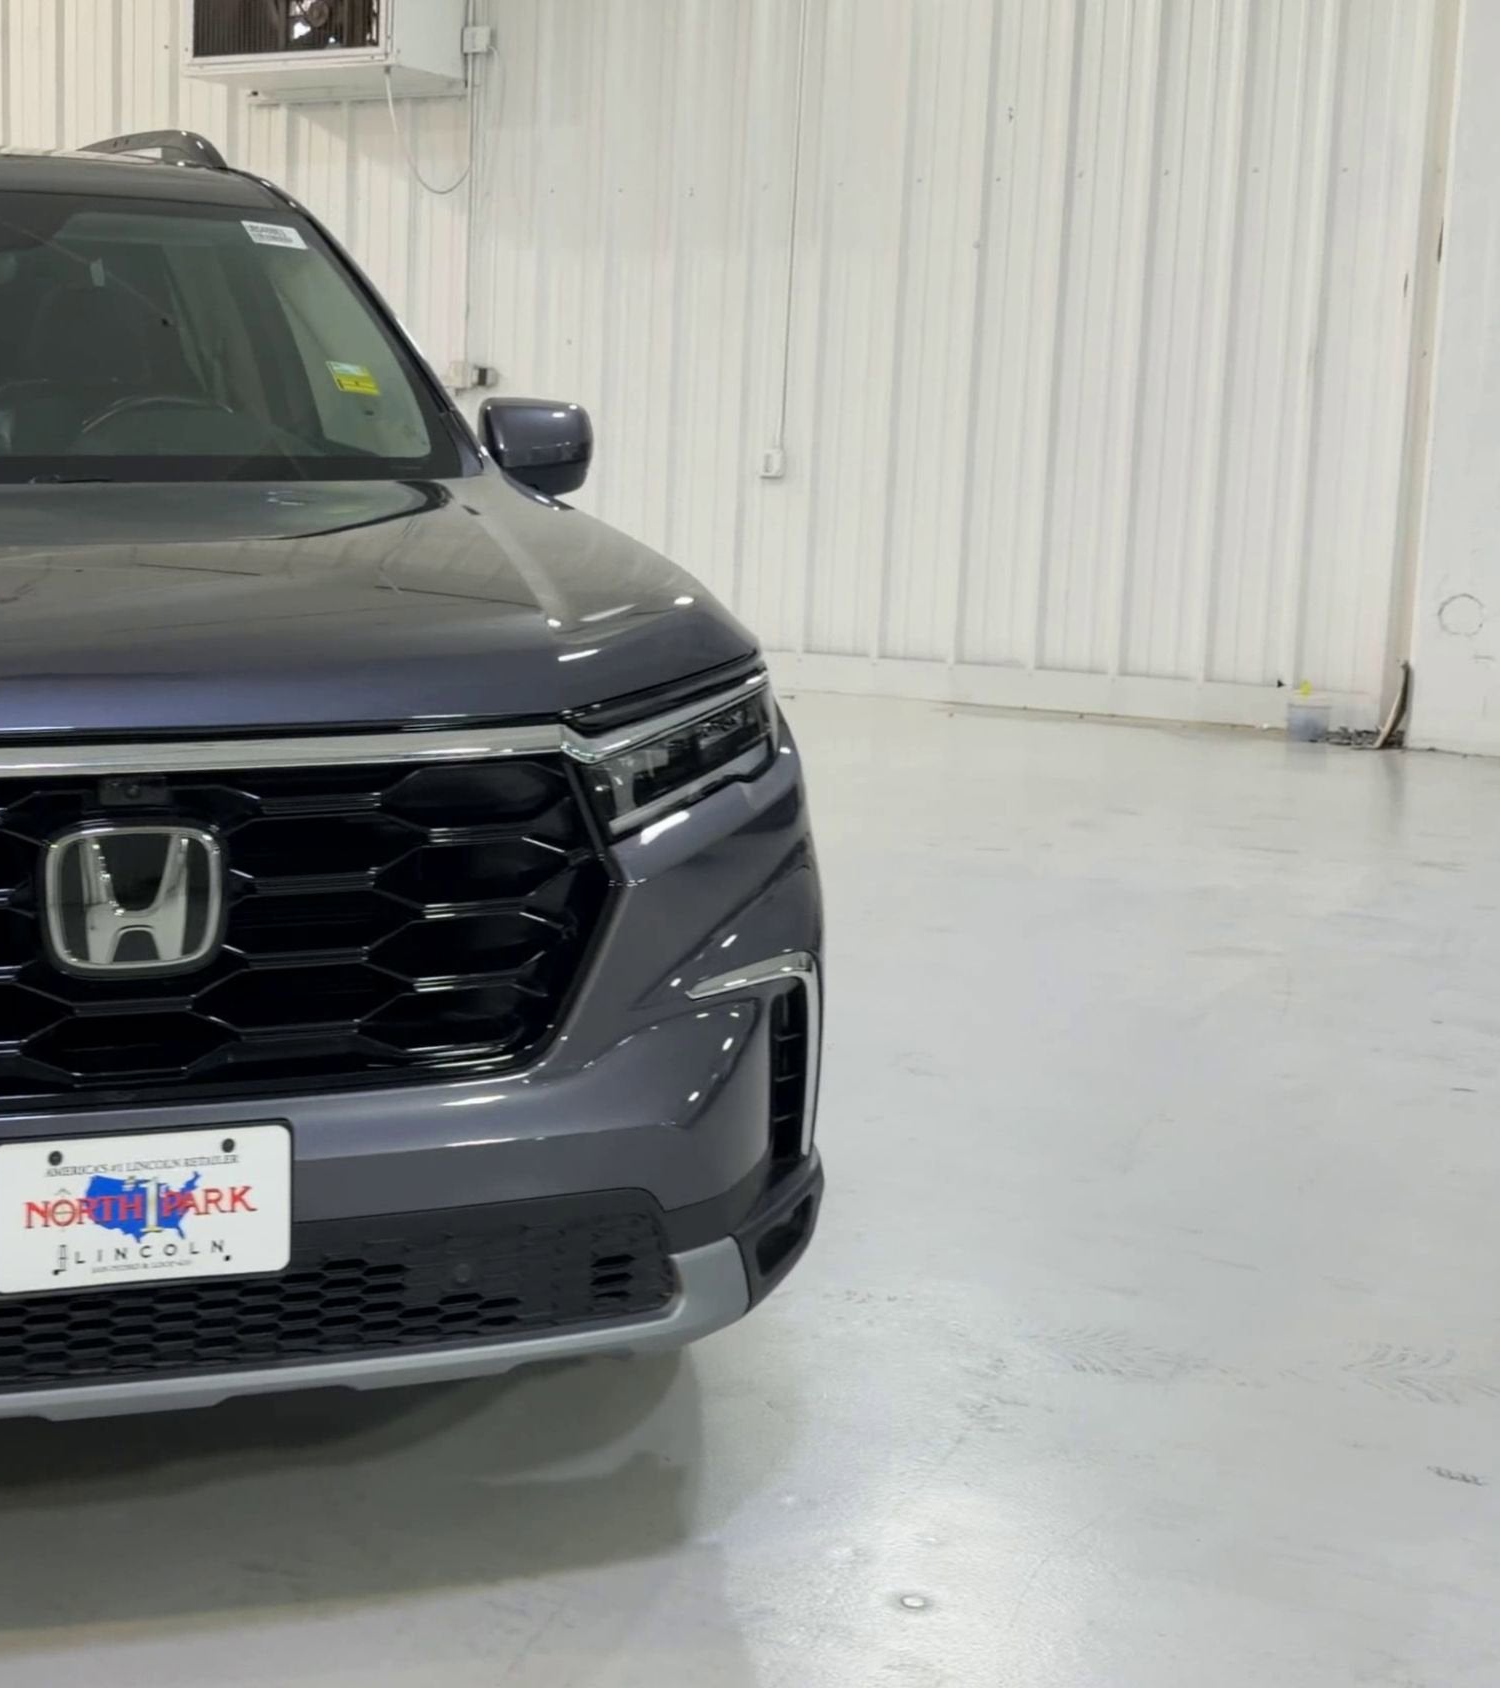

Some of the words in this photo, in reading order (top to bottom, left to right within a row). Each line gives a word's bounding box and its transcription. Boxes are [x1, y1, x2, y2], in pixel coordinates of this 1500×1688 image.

[127, 1160, 182, 1173] LINCOLN
[184, 1155, 240, 1168] RETAILER
[24, 1193, 144, 1228] NORTH
[161, 1185, 258, 1217] PARK
[74, 1240, 224, 1264] LINCOLN
